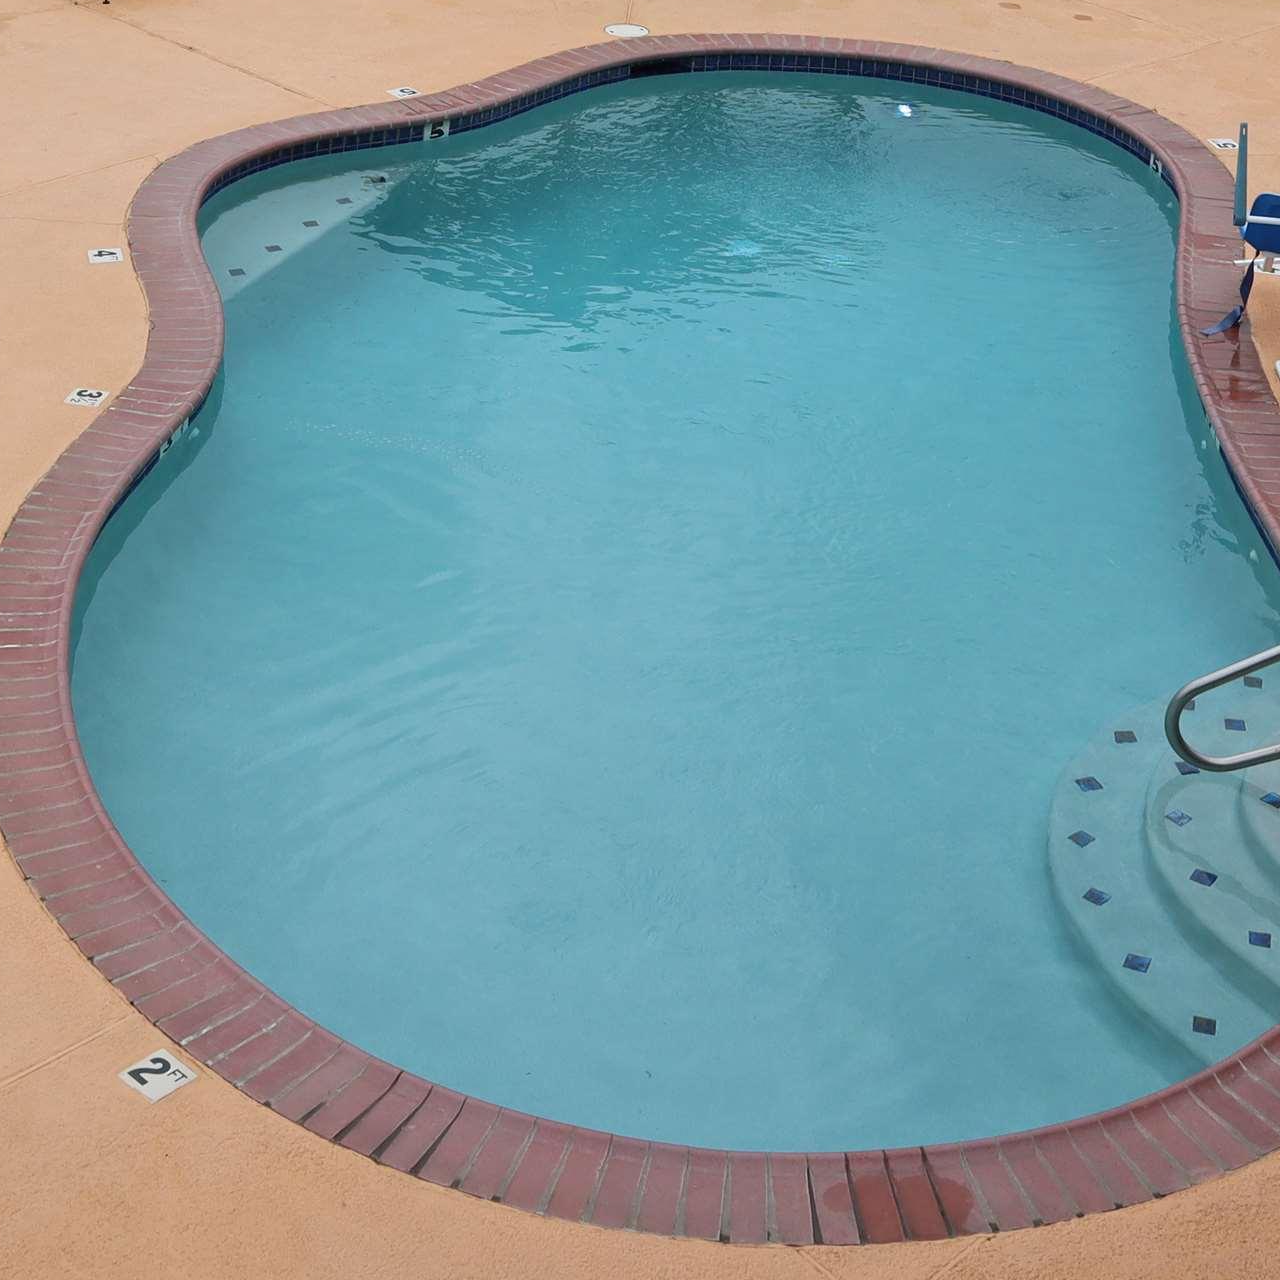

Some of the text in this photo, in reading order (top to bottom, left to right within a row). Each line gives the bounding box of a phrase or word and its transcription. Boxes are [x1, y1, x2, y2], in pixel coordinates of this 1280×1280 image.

[76, 389, 103, 399] 3
[127, 1056, 189, 1087] 2 FT
